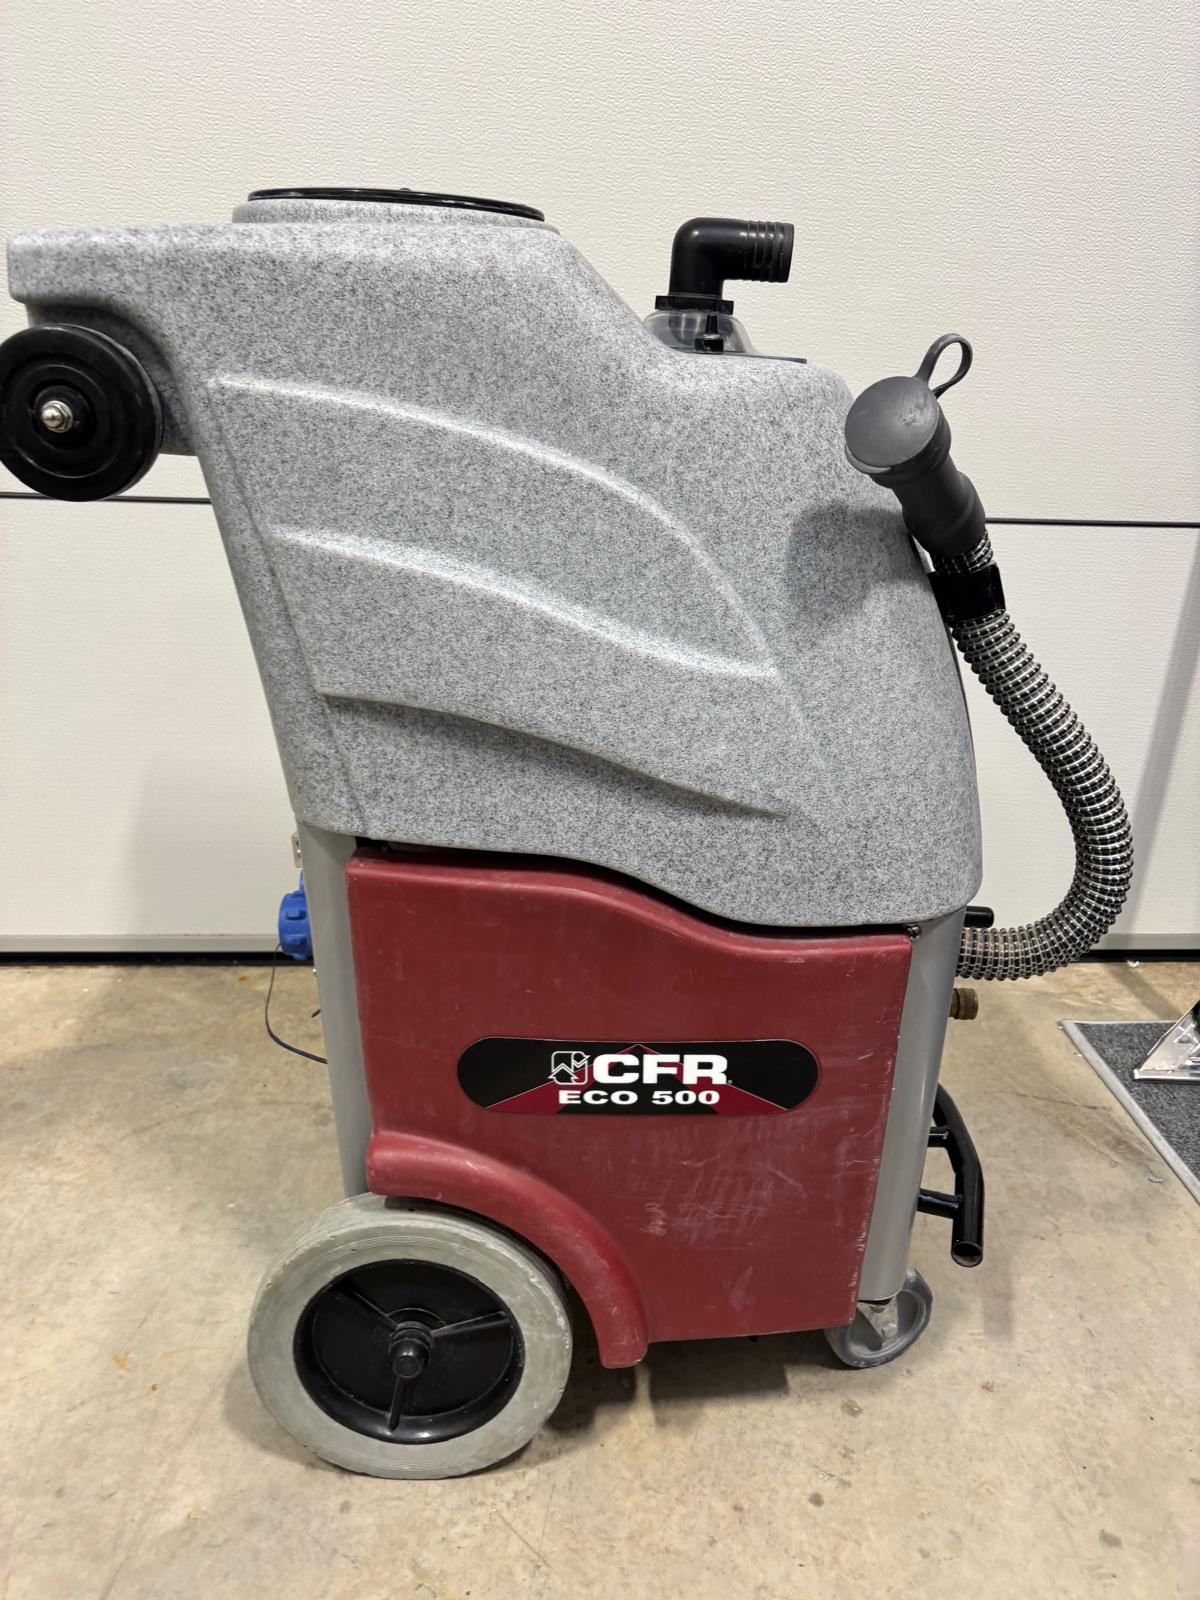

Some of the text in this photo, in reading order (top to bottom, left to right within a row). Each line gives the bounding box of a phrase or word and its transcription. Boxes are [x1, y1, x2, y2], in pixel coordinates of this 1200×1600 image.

[593, 1054, 728, 1084] CFR
[558, 1090, 720, 1105] ECO 500
